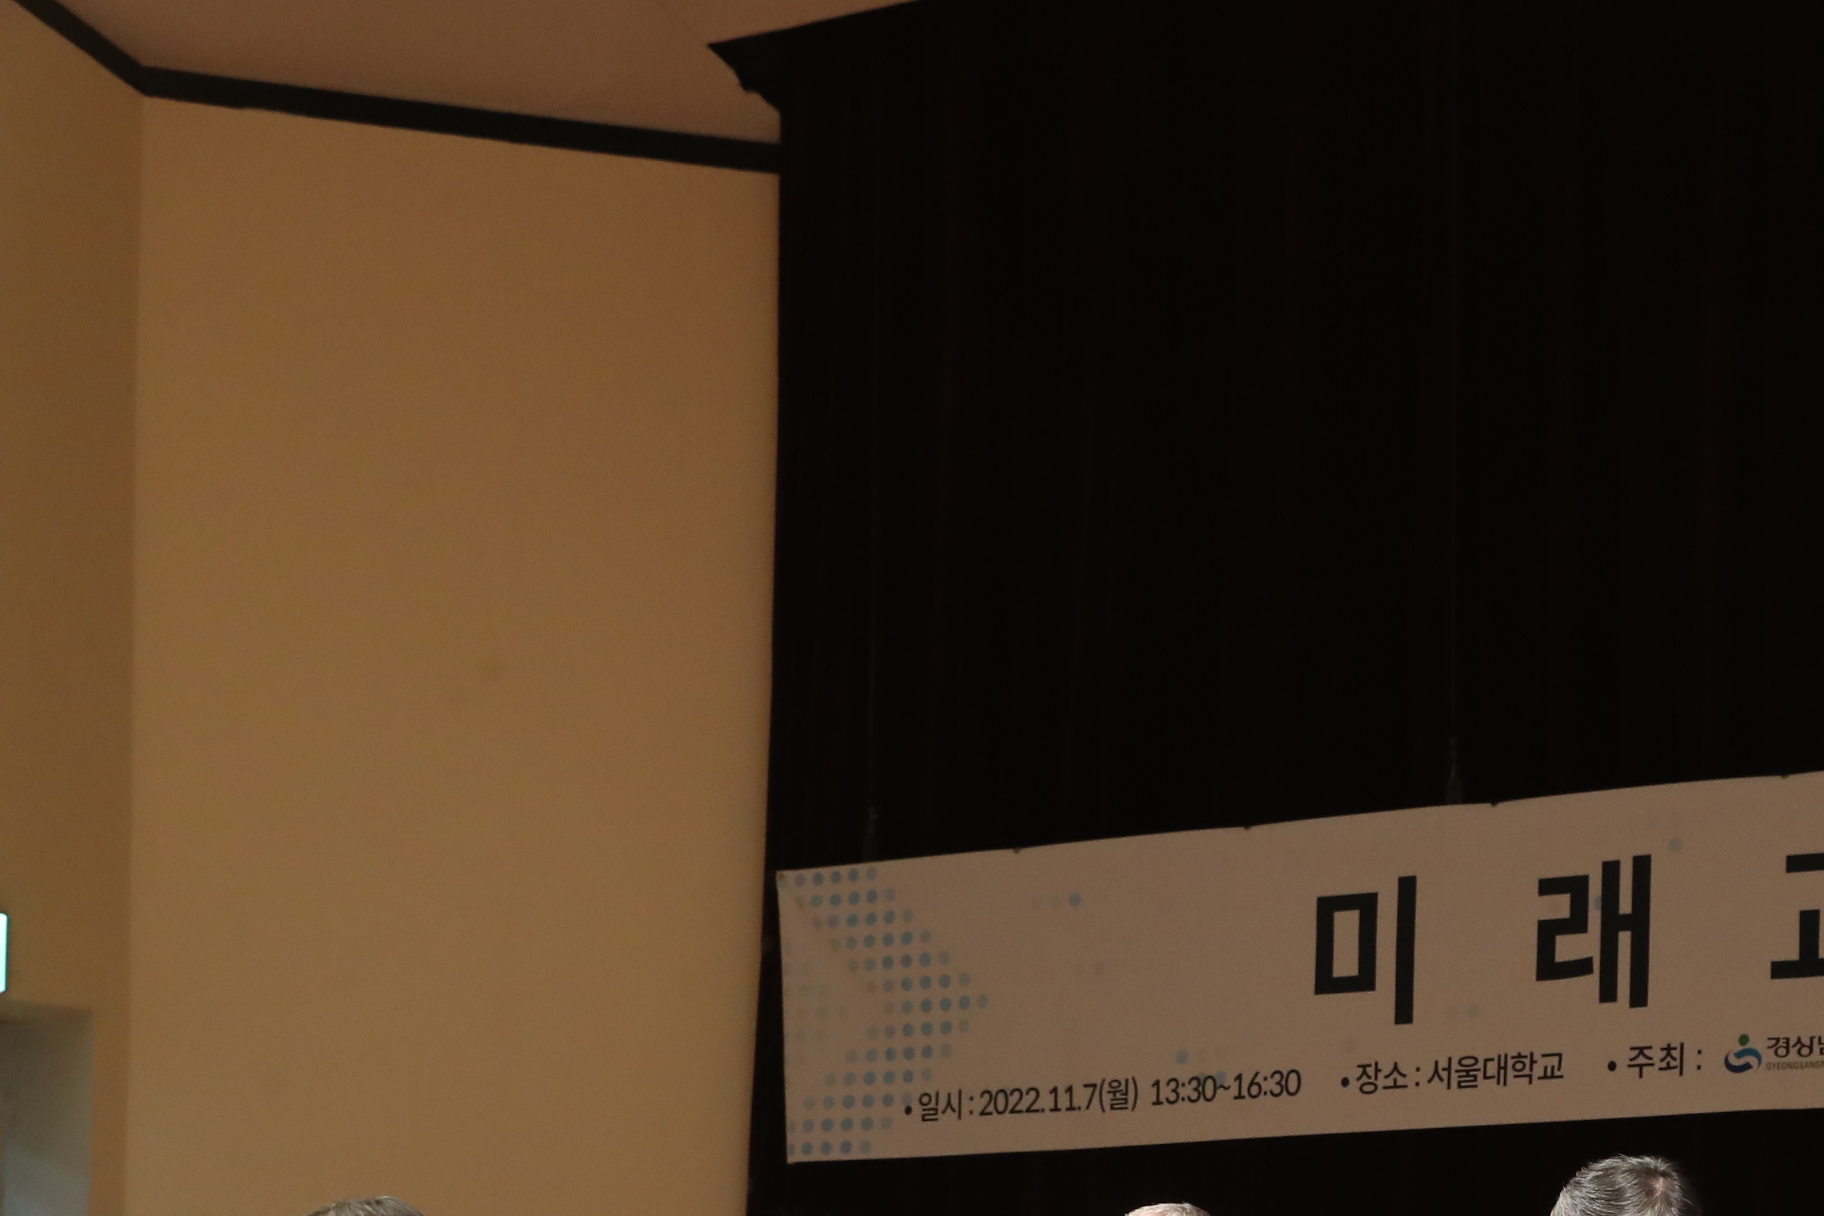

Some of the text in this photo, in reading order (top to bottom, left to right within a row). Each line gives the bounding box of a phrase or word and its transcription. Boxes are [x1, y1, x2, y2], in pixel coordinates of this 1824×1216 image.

[1426, 1051, 1565, 1091] 서울대학교
[1626, 1041, 1685, 1080] 주최
[1151, 1068, 1302, 1107] 13:30~16:30
